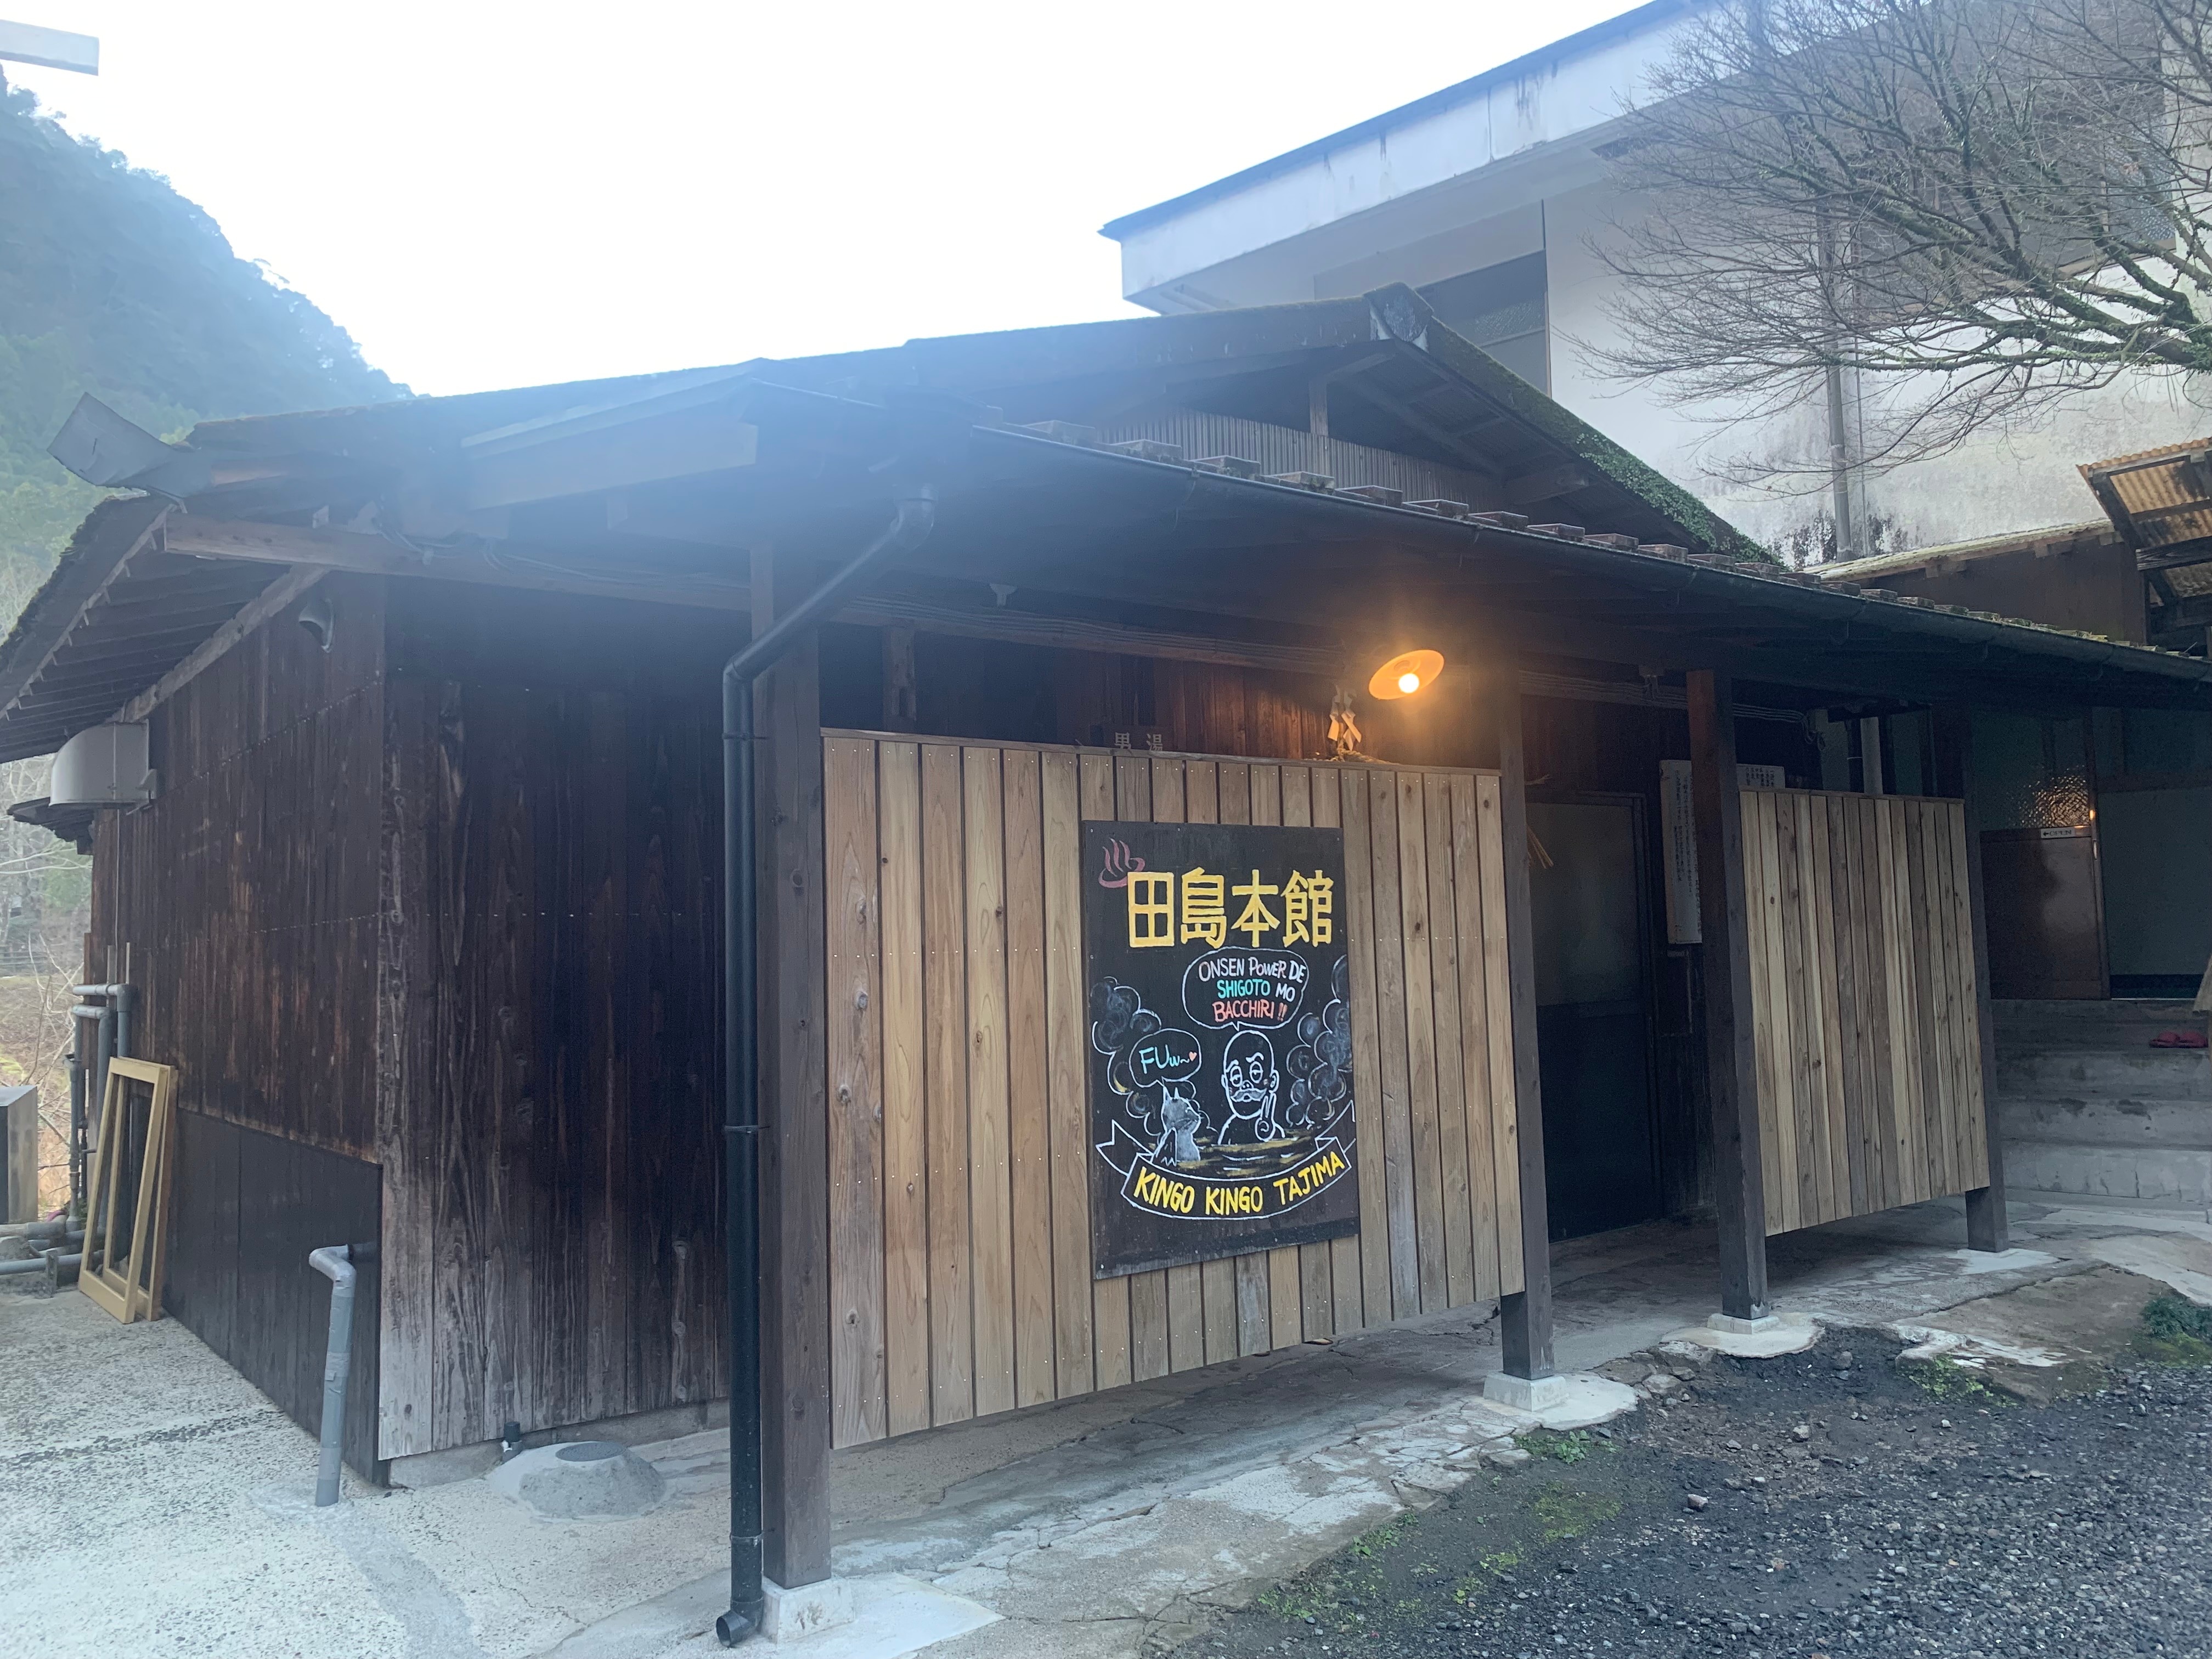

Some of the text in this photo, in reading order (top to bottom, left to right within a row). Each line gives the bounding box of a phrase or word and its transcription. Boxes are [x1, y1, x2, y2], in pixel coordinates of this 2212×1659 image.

[1127, 866, 1334, 948] 田島本館
[1199, 957, 1307, 984] ONSEN POWER DE
[1217, 980, 1295, 1002] SHIGOTO MO
[1212, 1000, 1274, 1022] BACCHIRI
[1133, 1151, 1345, 1216] KINGO KINGO TAJIMA
